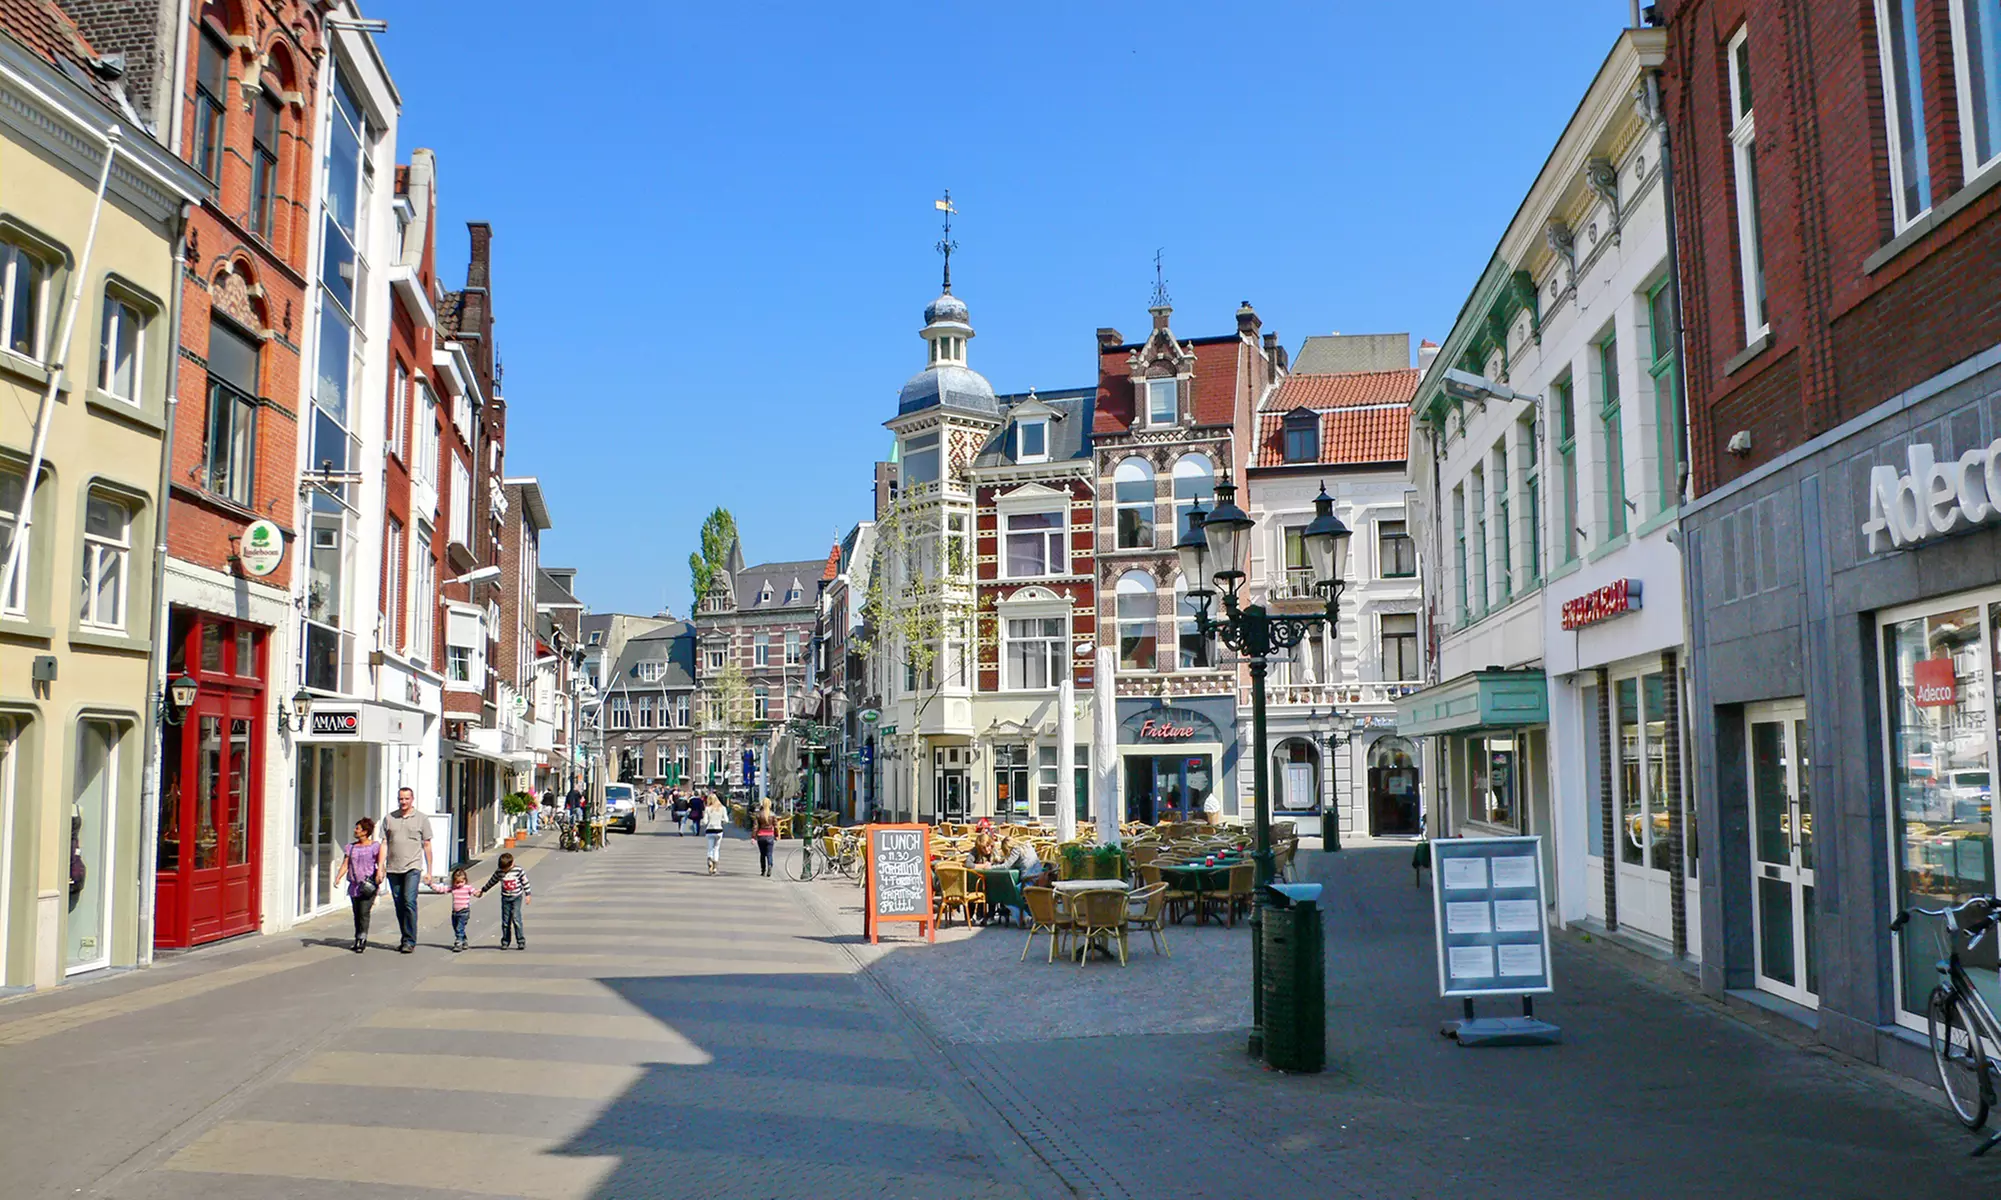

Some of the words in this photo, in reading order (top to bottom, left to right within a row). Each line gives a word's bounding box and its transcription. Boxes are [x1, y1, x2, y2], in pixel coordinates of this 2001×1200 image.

[1917, 683, 1951, 702] Adecco
[312, 715, 357, 731] AMANO
[1141, 719, 1194, 737] Friture
[881, 833, 920, 851] LUNCH
